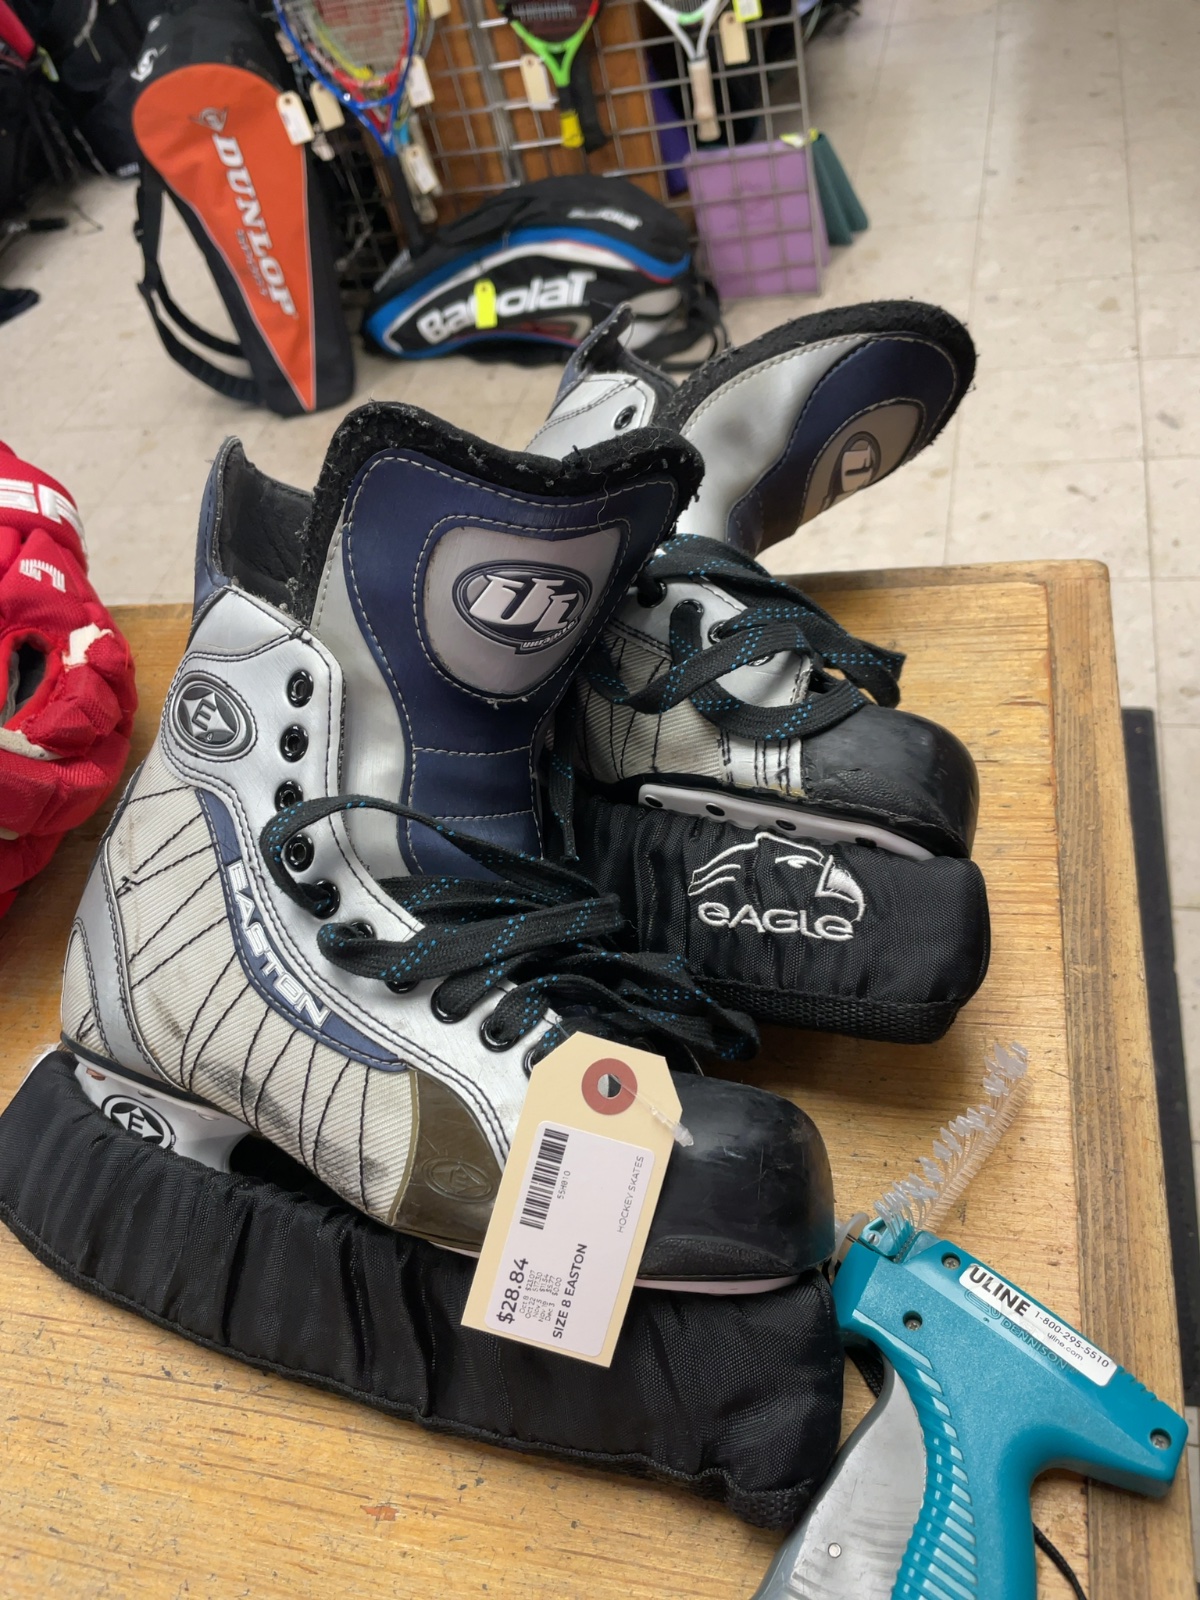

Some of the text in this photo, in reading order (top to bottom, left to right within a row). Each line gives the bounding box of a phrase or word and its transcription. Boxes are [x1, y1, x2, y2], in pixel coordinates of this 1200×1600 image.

[212, 133, 297, 316] DUNLOP
[228, 859, 331, 1028] EASTON
[616, 1155, 644, 1233] HOCKEY SKATES
[496, 1258, 529, 1324] $28.84
[519, 1301, 527, 1314] Oct
[525, 1270, 535, 1291] $23.07
[525, 1272, 543, 1319] Oct 22 $17.30
[532, 1305, 541, 1318] Nov
[539, 1274, 549, 1292] $11.54
[538, 1309, 546, 1322] Nov
[546, 1275, 555, 1293] $5.77
[545, 1308, 553, 1321] Dec
[552, 1277, 562, 1296] $0.00
[552, 1243, 588, 1339] SIZE 8 EASTON
[969, 1266, 1031, 1317] ULINE
[1000, 1317, 1068, 1370] DENNISON
[1034, 1310, 1109, 1368] 1-800-295-5510
[1047, 1332, 1084, 1361] uline.com
